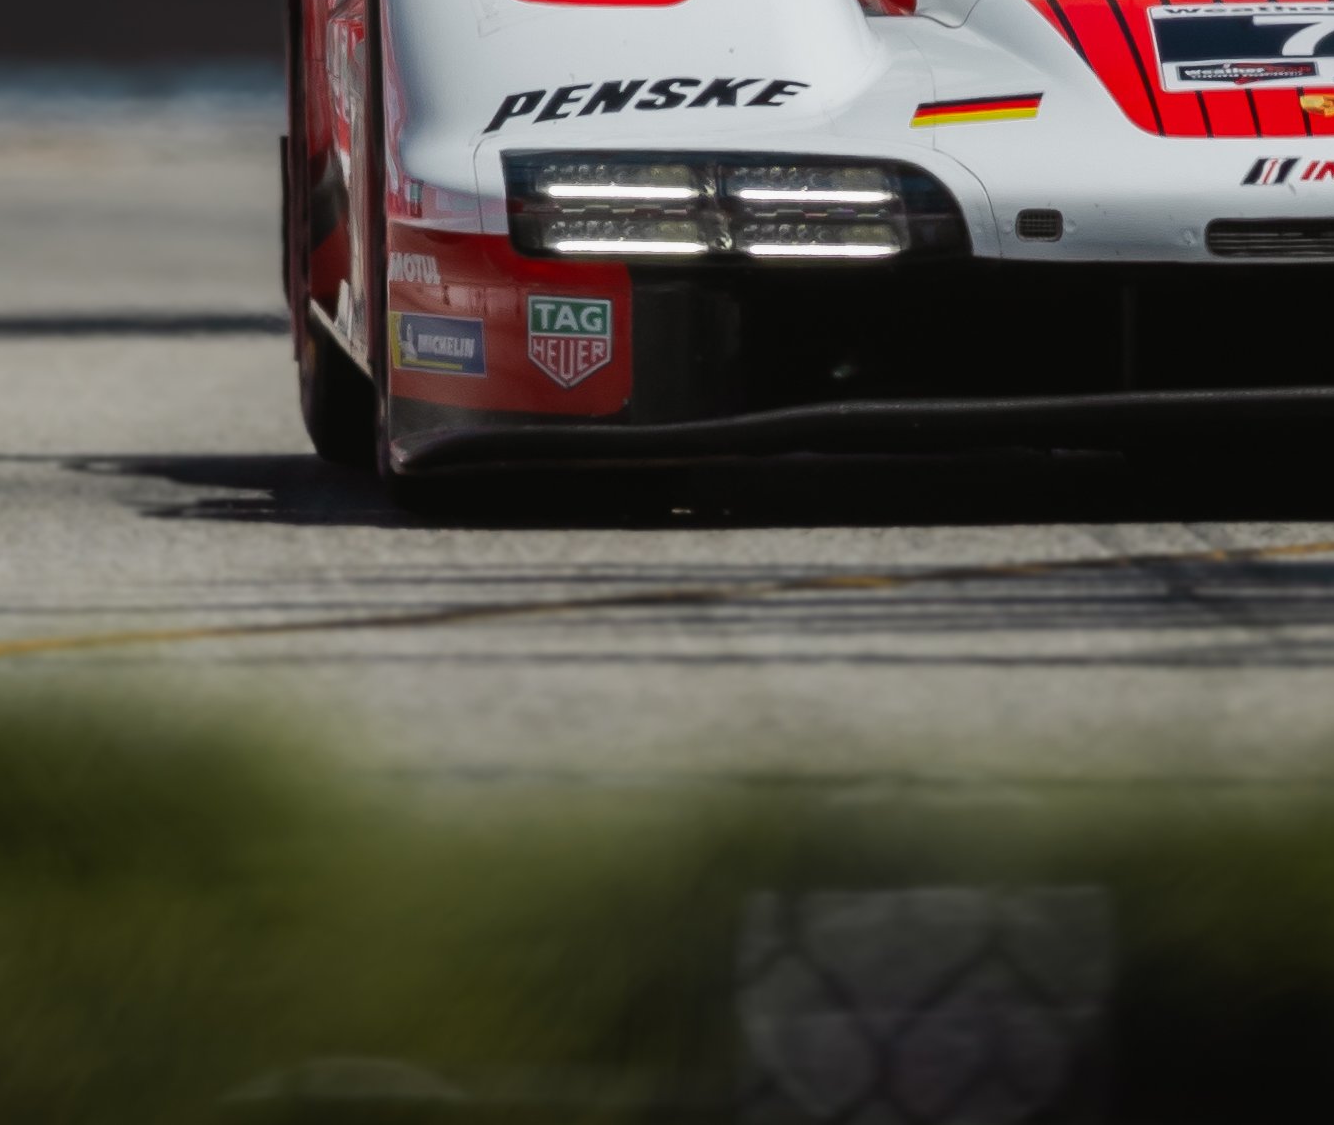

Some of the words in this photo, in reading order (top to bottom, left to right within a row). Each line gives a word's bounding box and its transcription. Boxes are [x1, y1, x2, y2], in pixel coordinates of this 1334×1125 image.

[483, 77, 810, 133] PENSKE
[535, 303, 603, 331] TAG
[532, 338, 605, 378] HEUER
